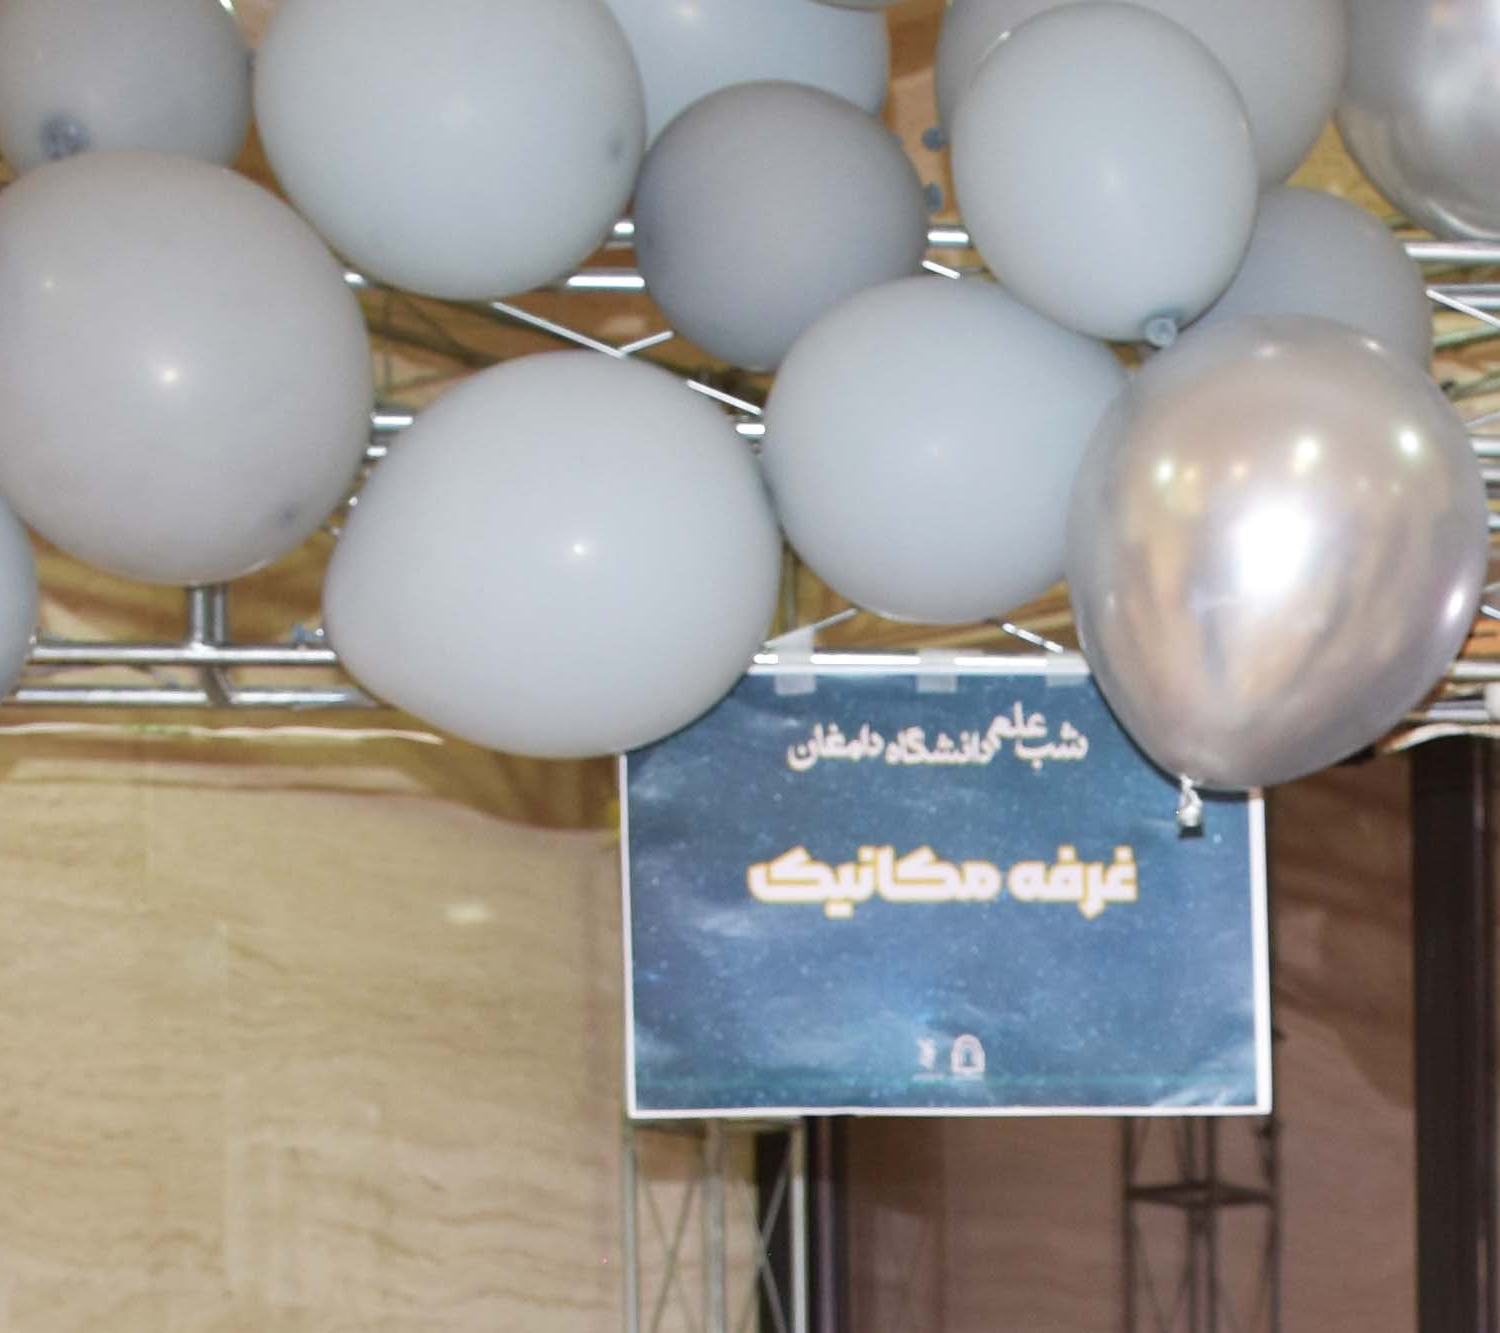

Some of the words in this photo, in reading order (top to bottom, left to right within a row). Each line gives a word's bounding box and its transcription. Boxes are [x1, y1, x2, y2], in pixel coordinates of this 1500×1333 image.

[787, 722, 884, 772] دامغان
[885, 726, 1000, 766] دانشگاه
[1015, 721, 1089, 772] شب
[747, 845, 1001, 918] مکانیک
[1009, 845, 1139, 919] غرفه
